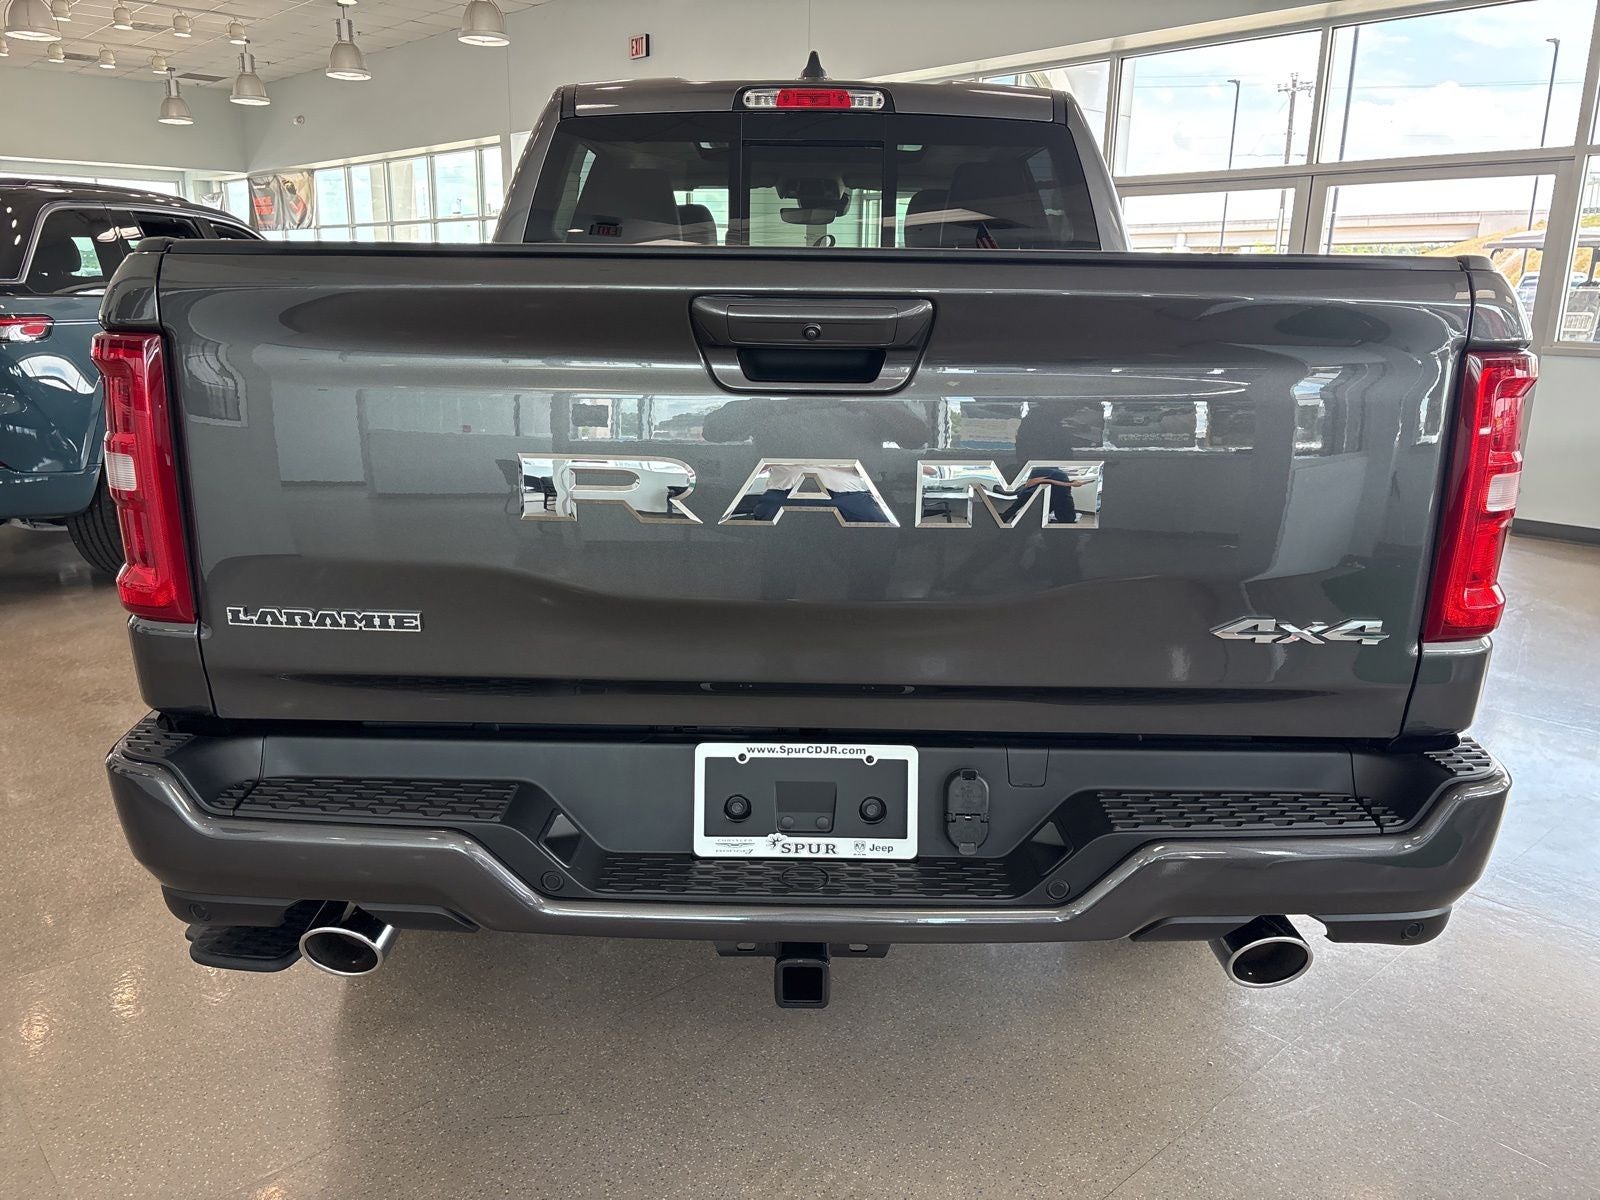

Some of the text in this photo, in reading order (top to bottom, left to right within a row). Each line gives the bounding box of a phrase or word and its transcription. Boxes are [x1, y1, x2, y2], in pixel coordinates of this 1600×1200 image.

[631, 36, 644, 57] EXIT
[517, 452, 1104, 529] RAM
[226, 605, 424, 632] LARAMIE
[746, 745, 867, 756] www.SpurCDJR.com
[780, 842, 838, 855] SPUR
[869, 843, 894, 853] Jeep
